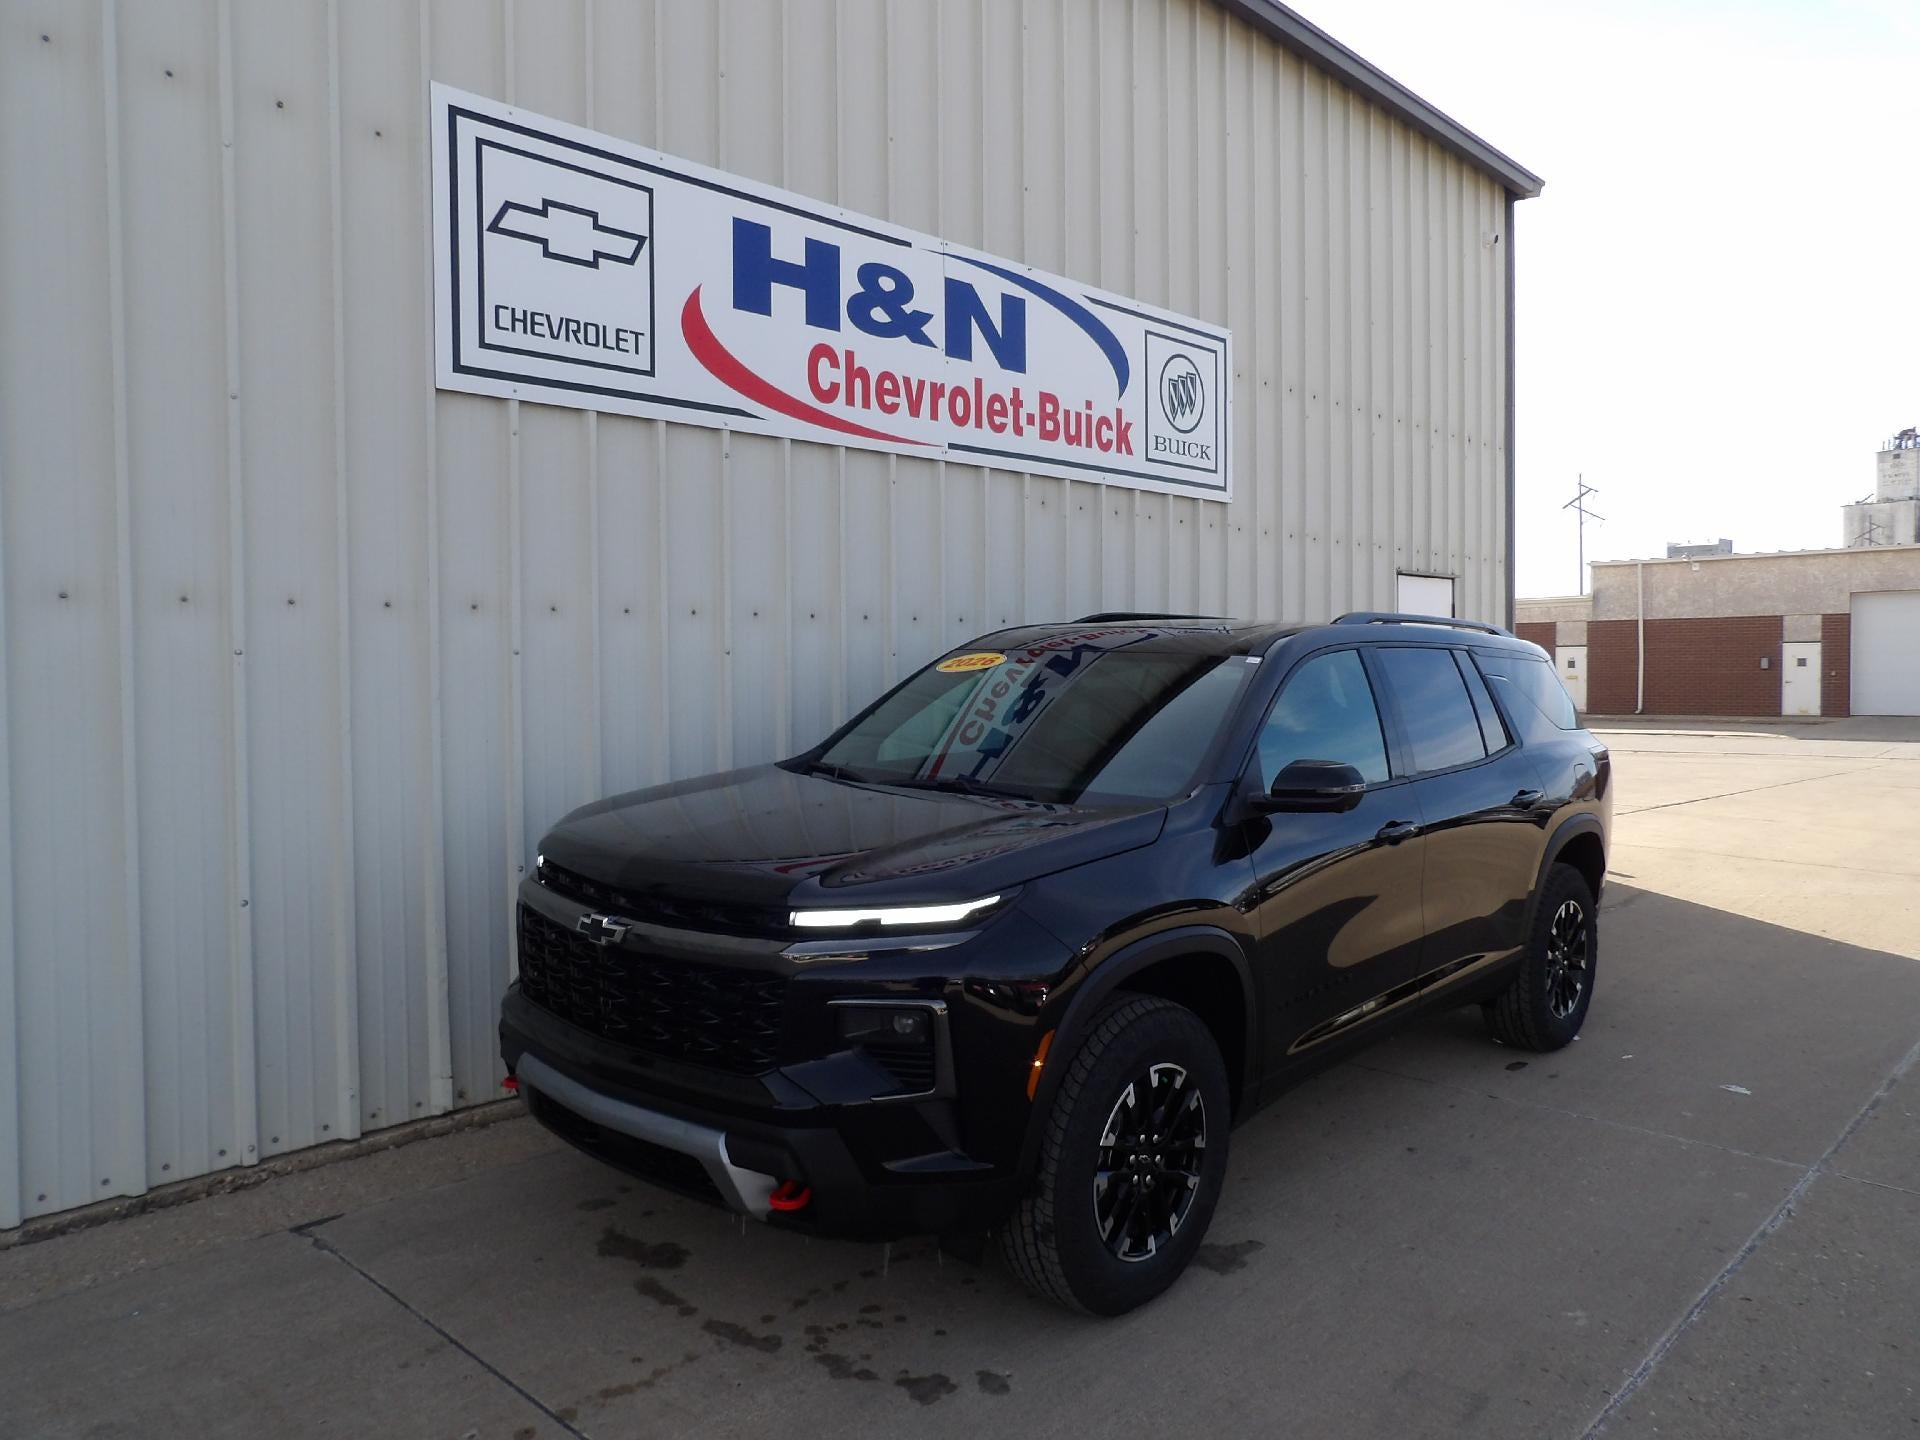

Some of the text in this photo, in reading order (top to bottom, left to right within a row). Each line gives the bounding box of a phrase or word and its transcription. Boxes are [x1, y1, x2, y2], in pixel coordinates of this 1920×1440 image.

[732, 216, 1026, 374] H&N
[494, 304, 645, 355] CHEVROLET
[807, 343, 1134, 456] Chevrolet-Buick
[1153, 434, 1211, 461] BUICK
[943, 656, 1001, 669] 2026
